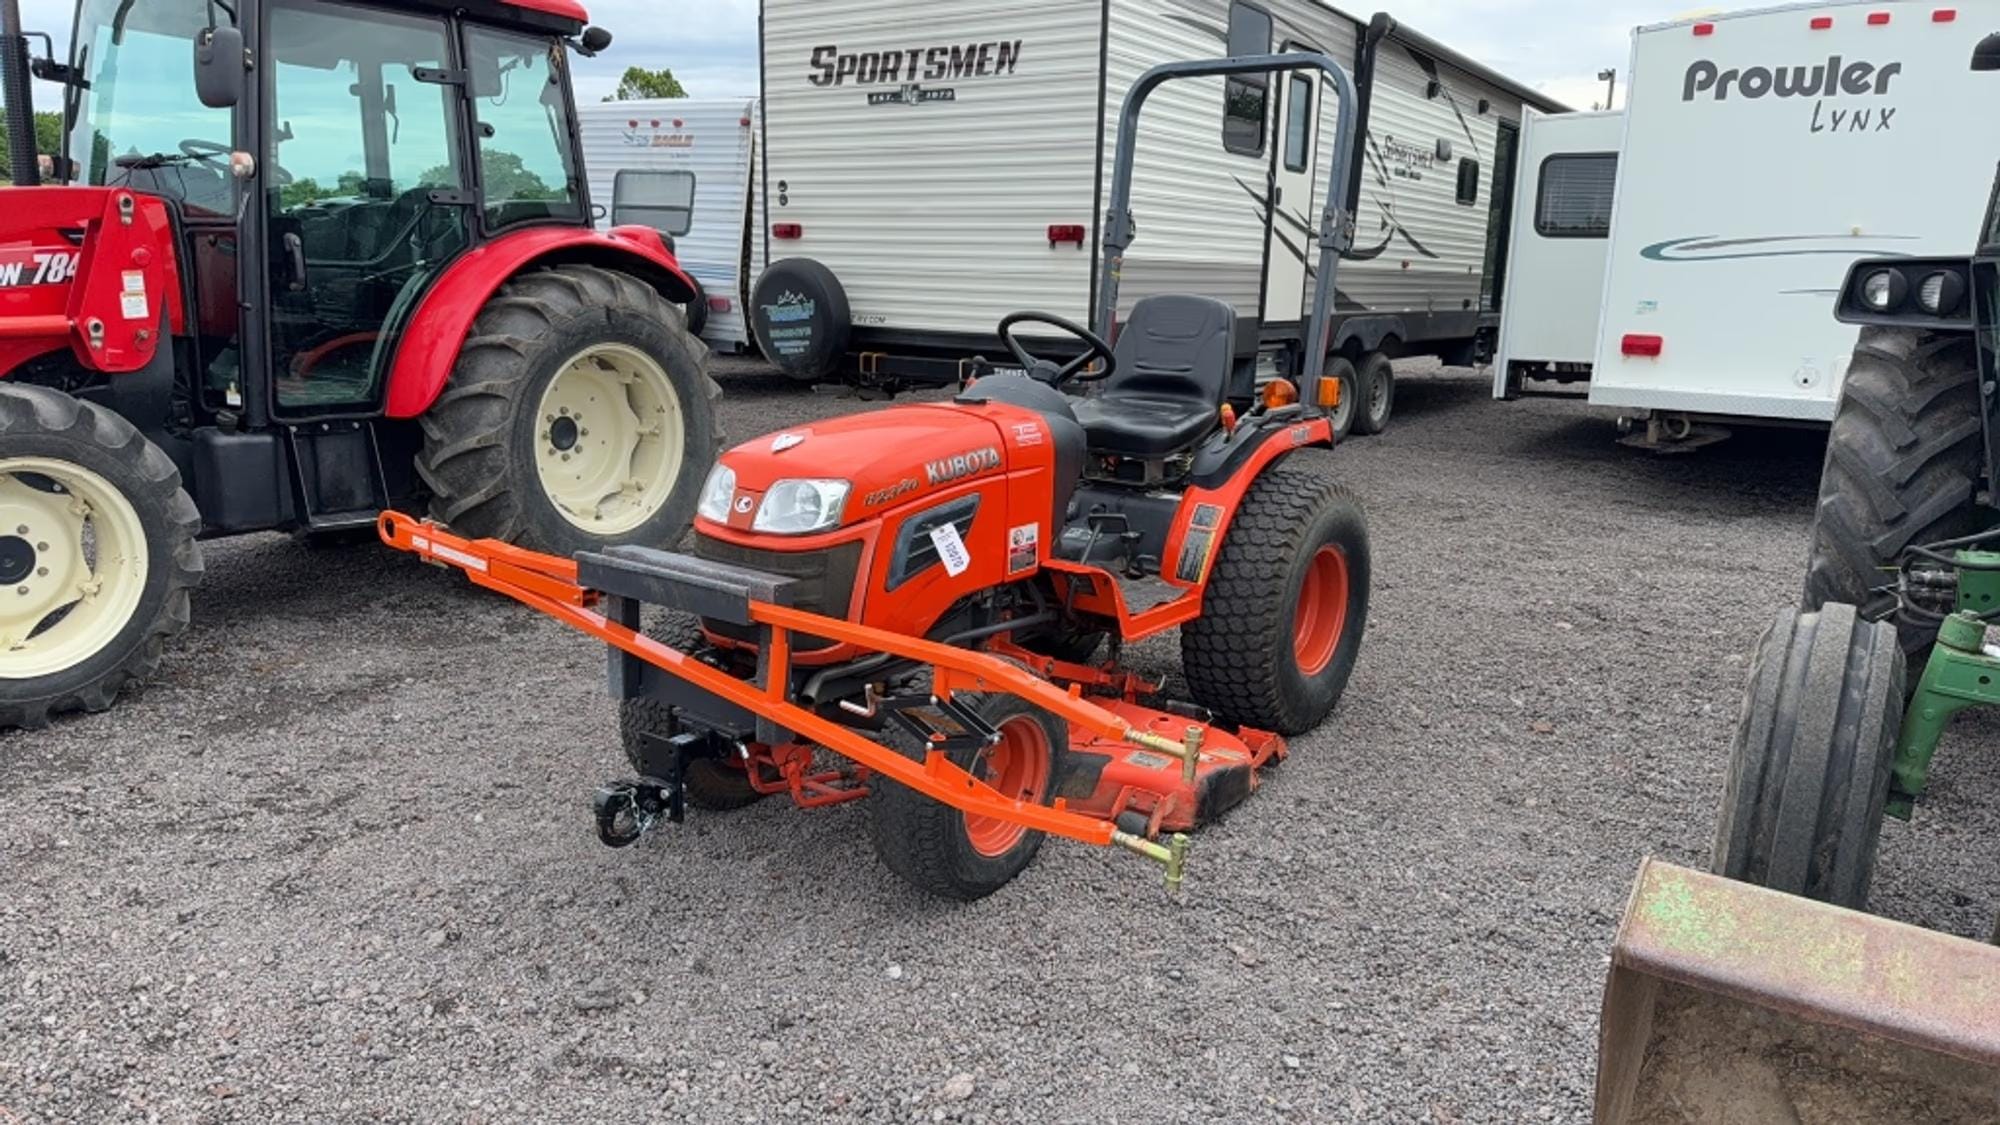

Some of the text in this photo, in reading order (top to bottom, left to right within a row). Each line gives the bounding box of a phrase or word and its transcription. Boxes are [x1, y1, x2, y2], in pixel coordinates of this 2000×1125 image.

[808, 40, 1022, 87] SPORTSMEN
[1682, 55, 1902, 101] Prowler
[1810, 100, 1896, 133] LYNX
[926, 448, 1000, 484] KUBOTA
